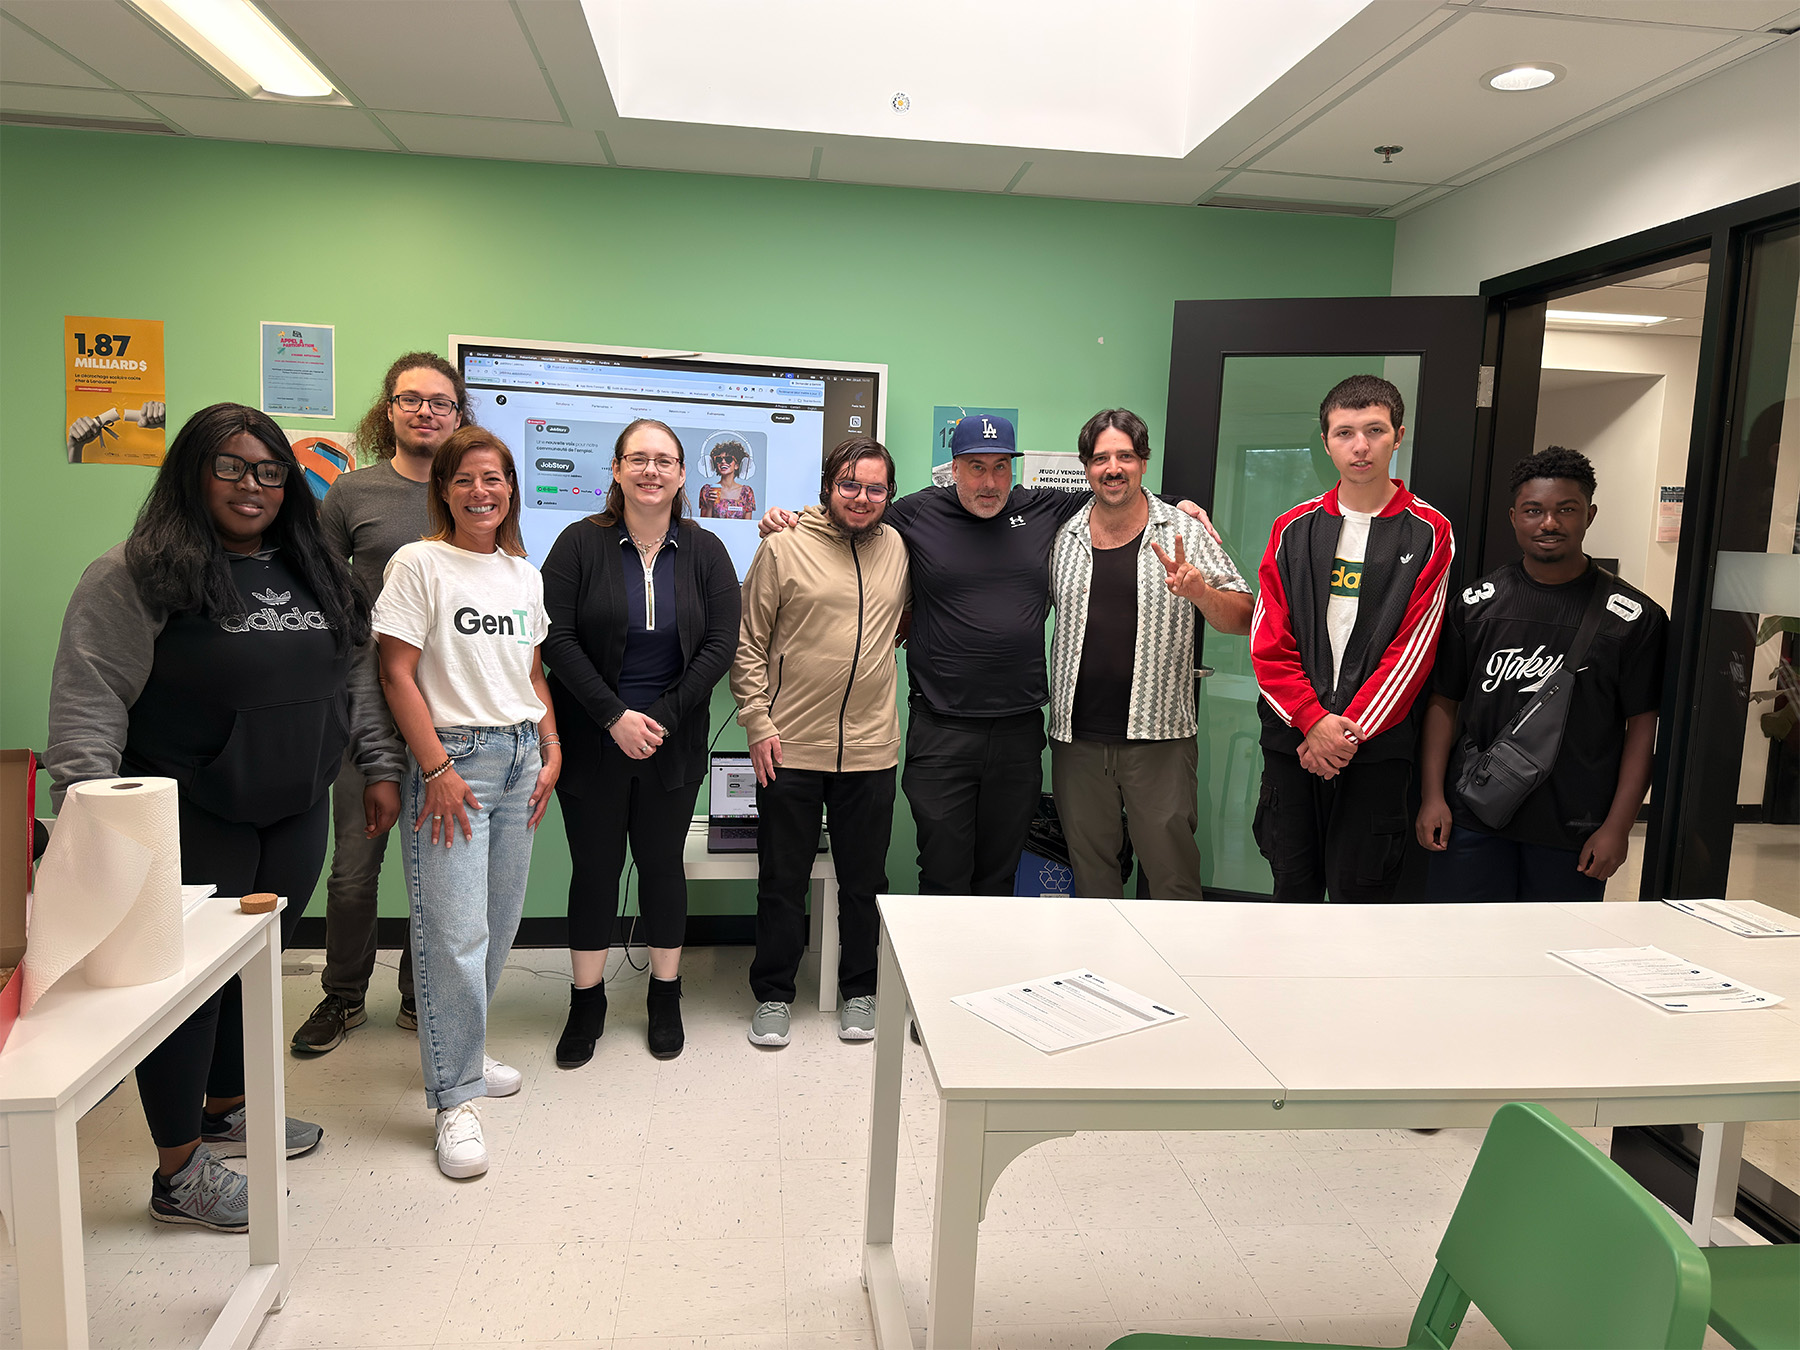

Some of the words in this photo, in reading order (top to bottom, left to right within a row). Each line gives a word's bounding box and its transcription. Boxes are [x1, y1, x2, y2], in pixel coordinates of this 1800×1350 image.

[74, 333, 131, 357] 1,87
[981, 418, 998, 439] LA
[540, 461, 570, 470] JobStory
[220, 606, 338, 633] adida
[1481, 645, 1565, 693] Toky
